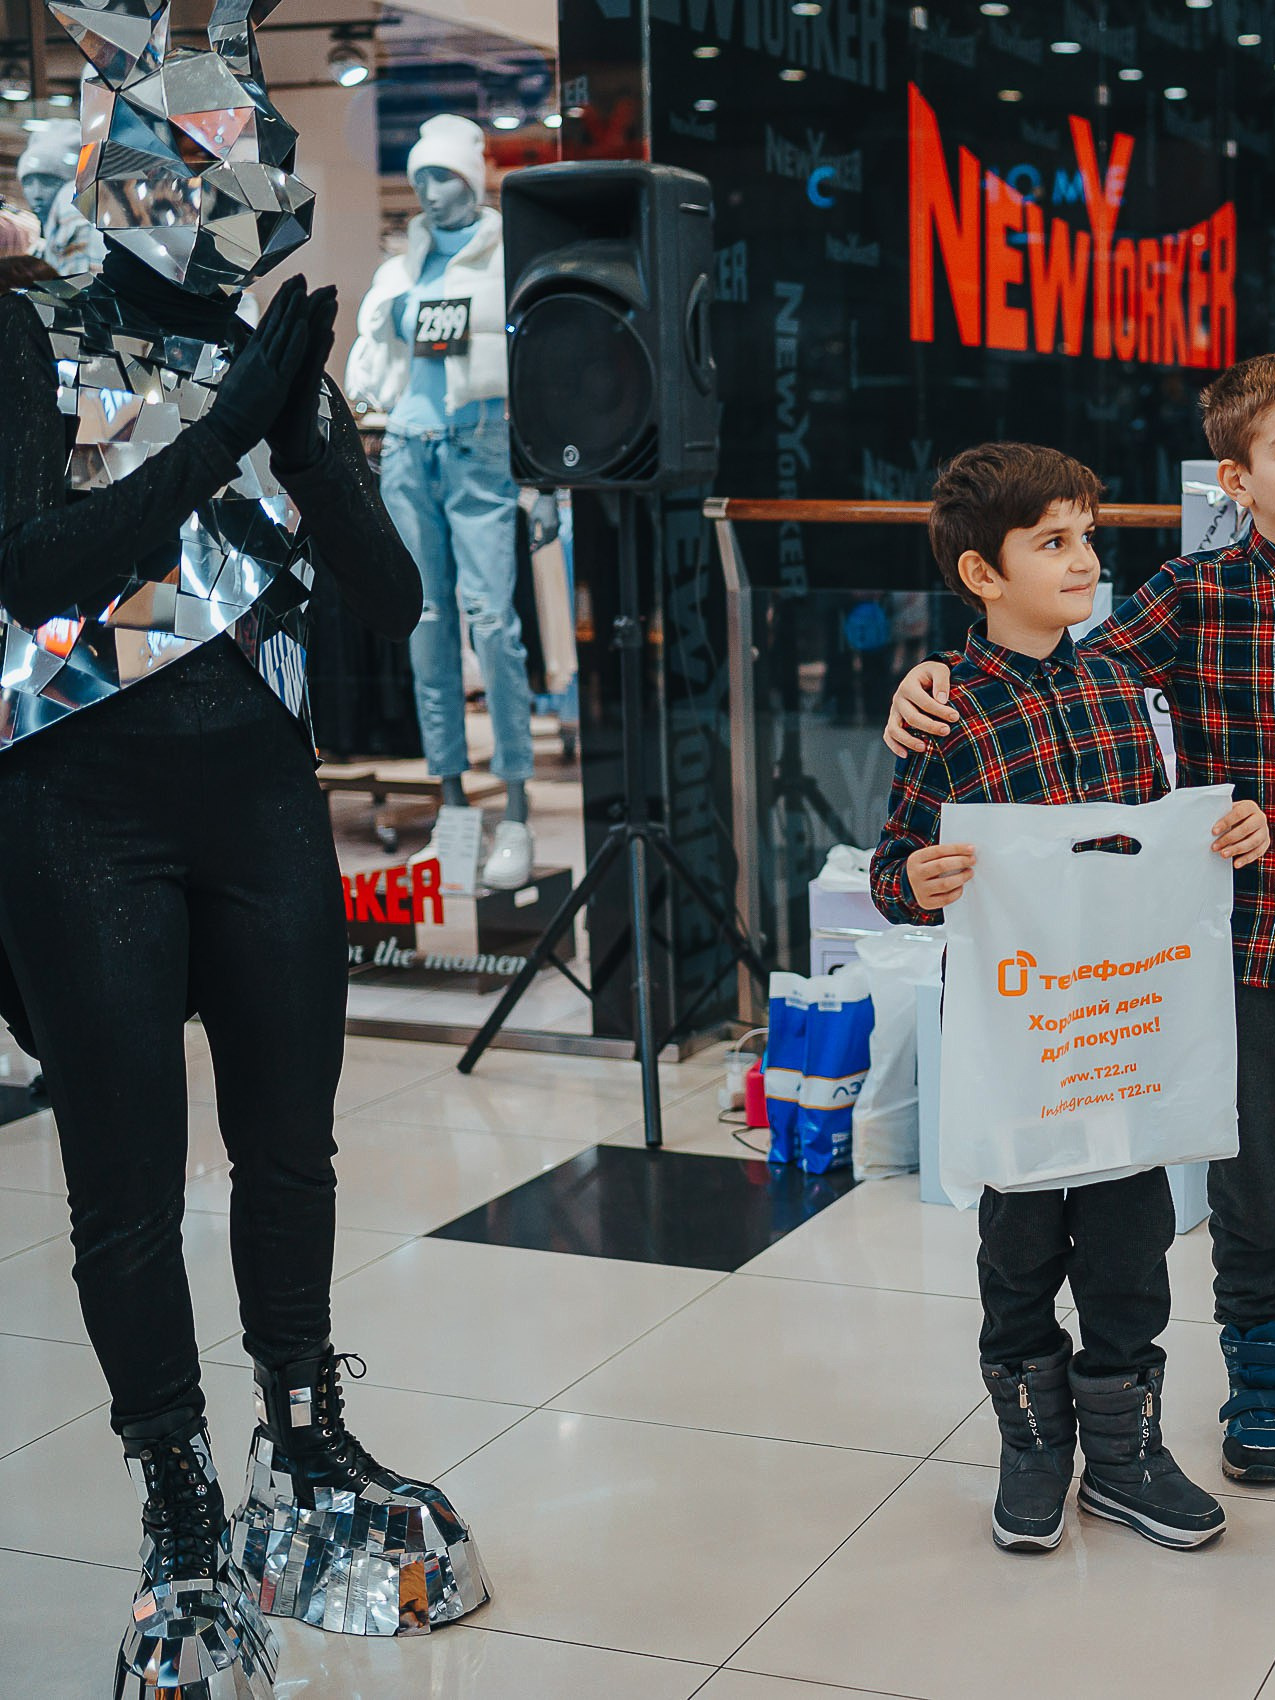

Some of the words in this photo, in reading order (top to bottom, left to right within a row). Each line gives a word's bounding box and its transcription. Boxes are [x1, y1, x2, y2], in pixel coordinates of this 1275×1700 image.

[908, 80, 1237, 371] NEWYORKER
[416, 304, 468, 342] 2399
[424, 951, 530, 975] momen
[1028, 999, 1110, 1034] Хороший
[1115, 992, 1163, 1015] день
[1073, 1016, 1161, 1048] покупок!
[1060, 1063, 1137, 1088] www.T22.ru
[1041, 1092, 1115, 1119] Instagram:
[1118, 1083, 1161, 1100] T22.ru
